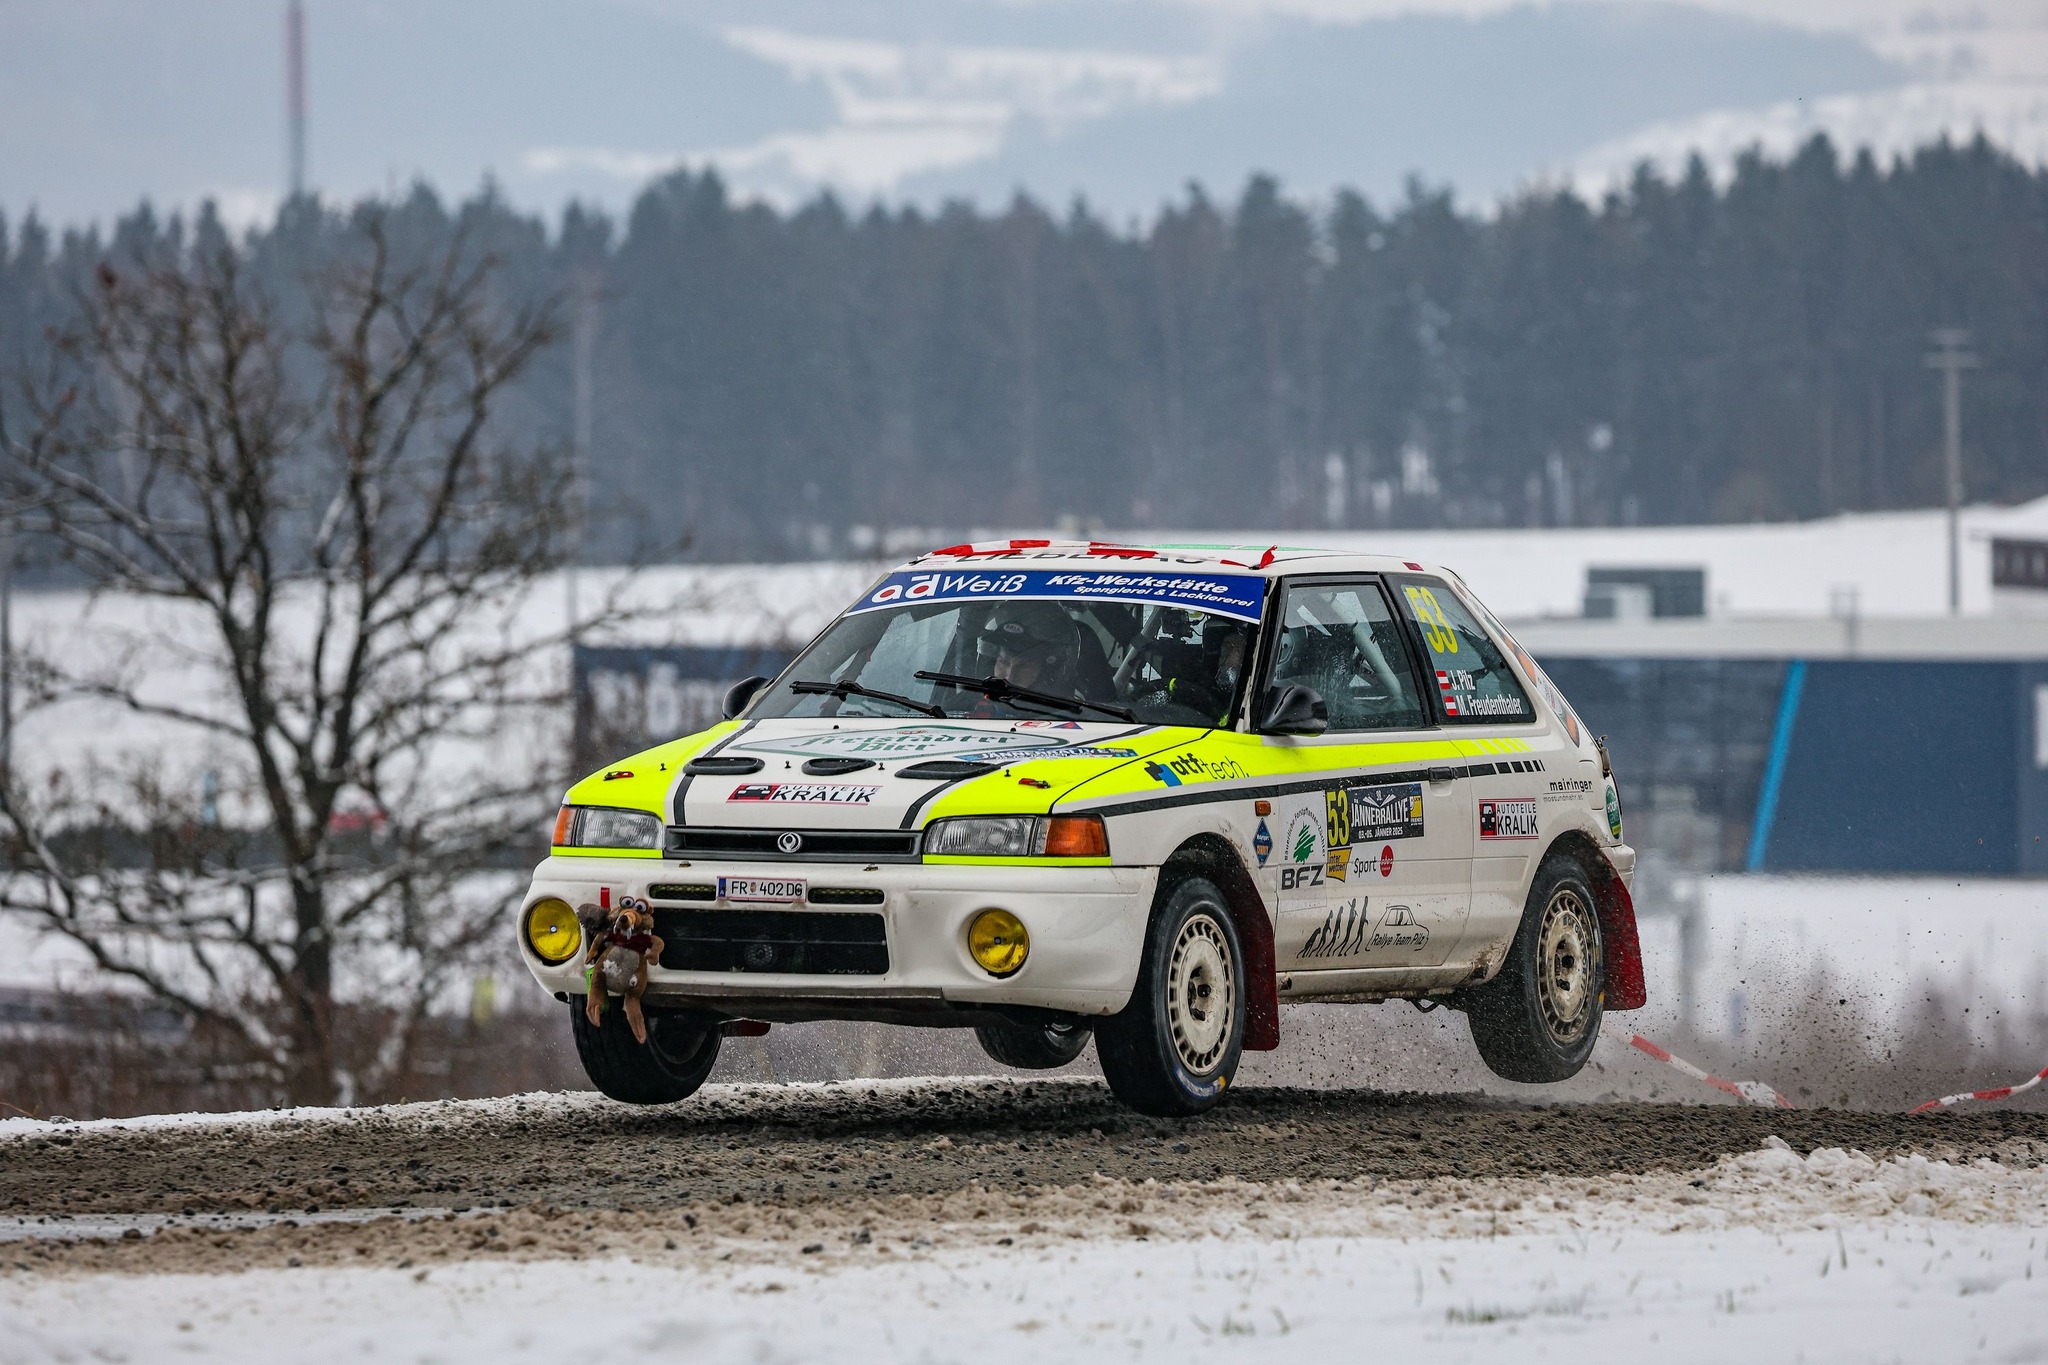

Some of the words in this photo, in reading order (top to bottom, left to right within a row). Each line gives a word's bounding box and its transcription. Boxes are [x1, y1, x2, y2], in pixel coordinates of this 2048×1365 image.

[942, 574, 1028, 593] Weiß
[1046, 574, 1229, 594] Kfz-Werkstätte
[1073, 585, 1151, 596] Spenglerei
[1154, 588, 1165, 596] &
[1169, 589, 1255, 608] Lackiererei
[1405, 586, 1458, 654] 53
[1450, 670, 1460, 691] J.
[1457, 670, 1476, 690] Pilz
[1456, 694, 1469, 716] M.
[1467, 693, 1522, 715] Freudenthaler
[780, 785, 882, 793] AUTOTEILE
[1550, 778, 1592, 793] mairinger
[771, 790, 876, 803] KRALIK
[1327, 789, 1350, 846] 53
[1351, 797, 1409, 828] JÄNNERRALLYE
[1497, 803, 1537, 815] AUTOTEILE
[1374, 827, 1392, 838] JÄNNER
[1497, 815, 1539, 835] KRALIK
[1353, 856, 1377, 878] Sport
[1281, 865, 1325, 890] BFZ
[731, 880, 748, 896] FR
[759, 882, 784, 896] 402
[1371, 933, 1393, 949] Rallye
[1393, 933, 1411, 946] Team
[1410, 933, 1425, 945] Pilz
